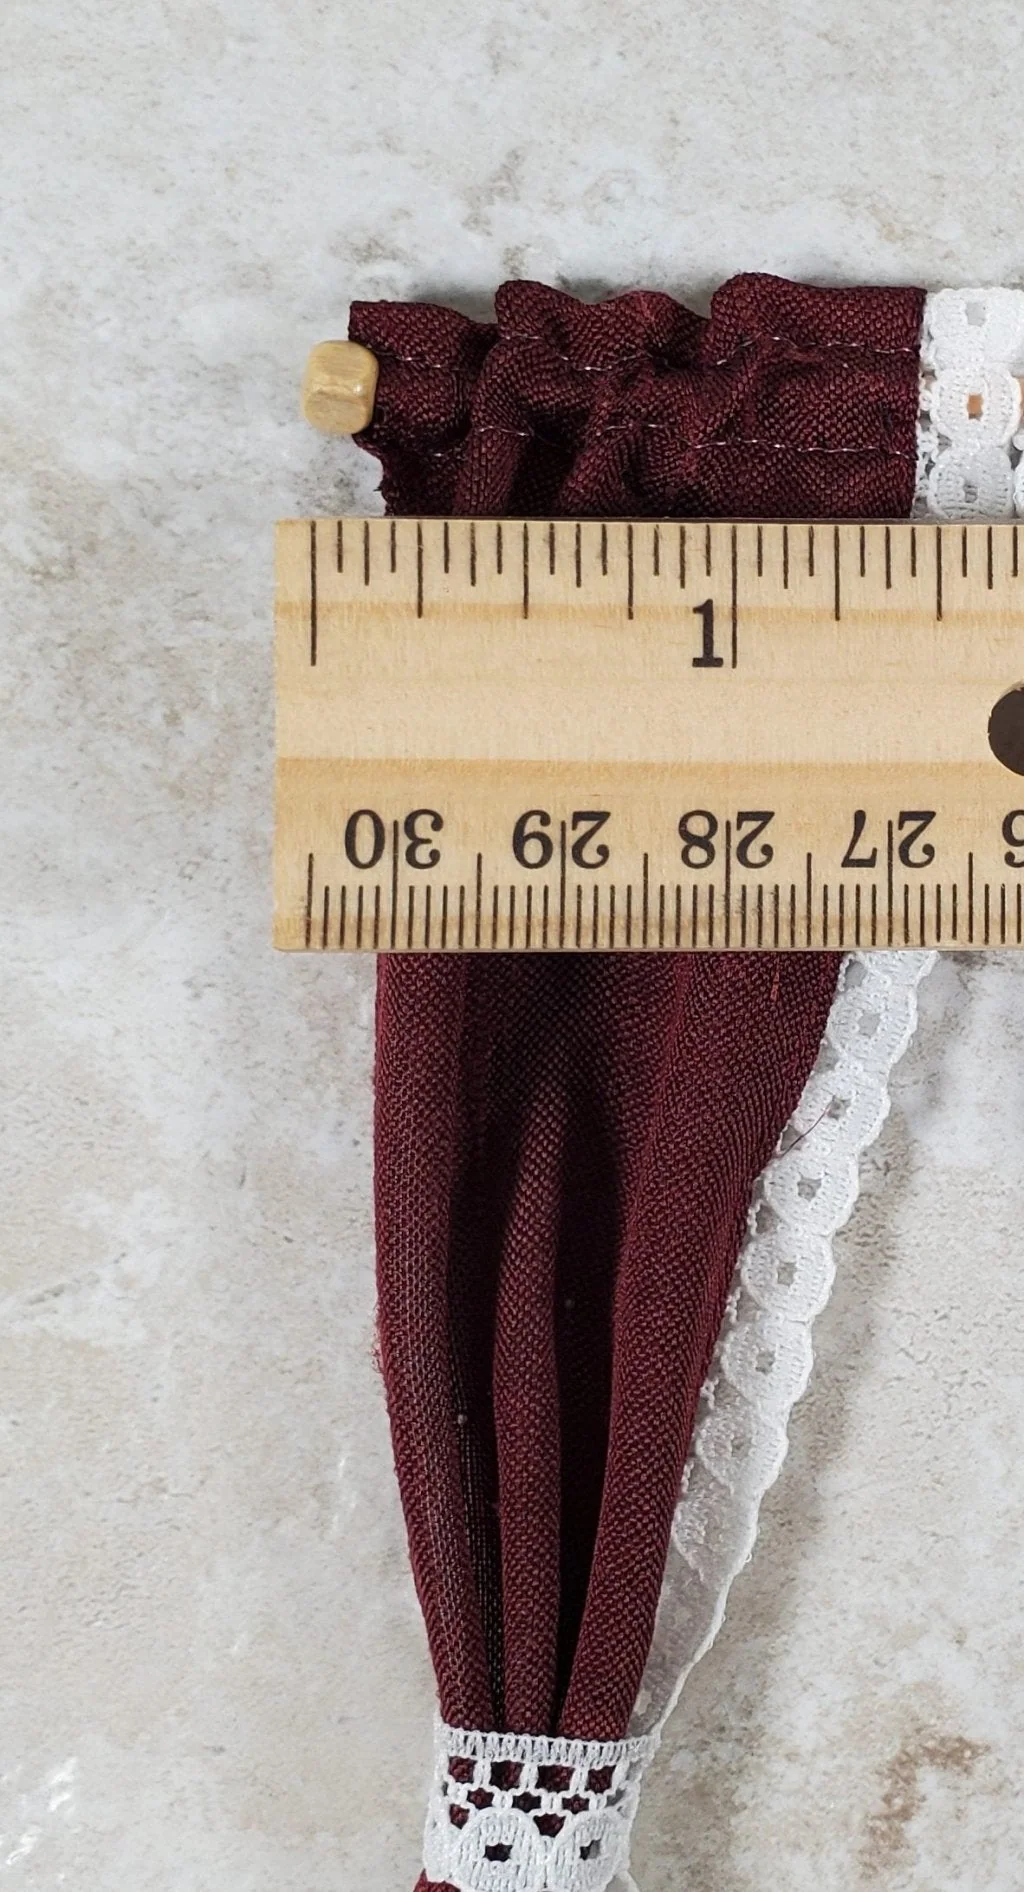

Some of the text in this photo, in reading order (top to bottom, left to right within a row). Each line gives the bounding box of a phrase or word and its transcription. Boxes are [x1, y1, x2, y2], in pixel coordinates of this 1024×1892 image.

[691, 598, 724, 668] 1
[344, 808, 444, 870] 30
[511, 809, 612, 870] 29
[677, 809, 776, 870] 28
[840, 809, 937, 869] 27
